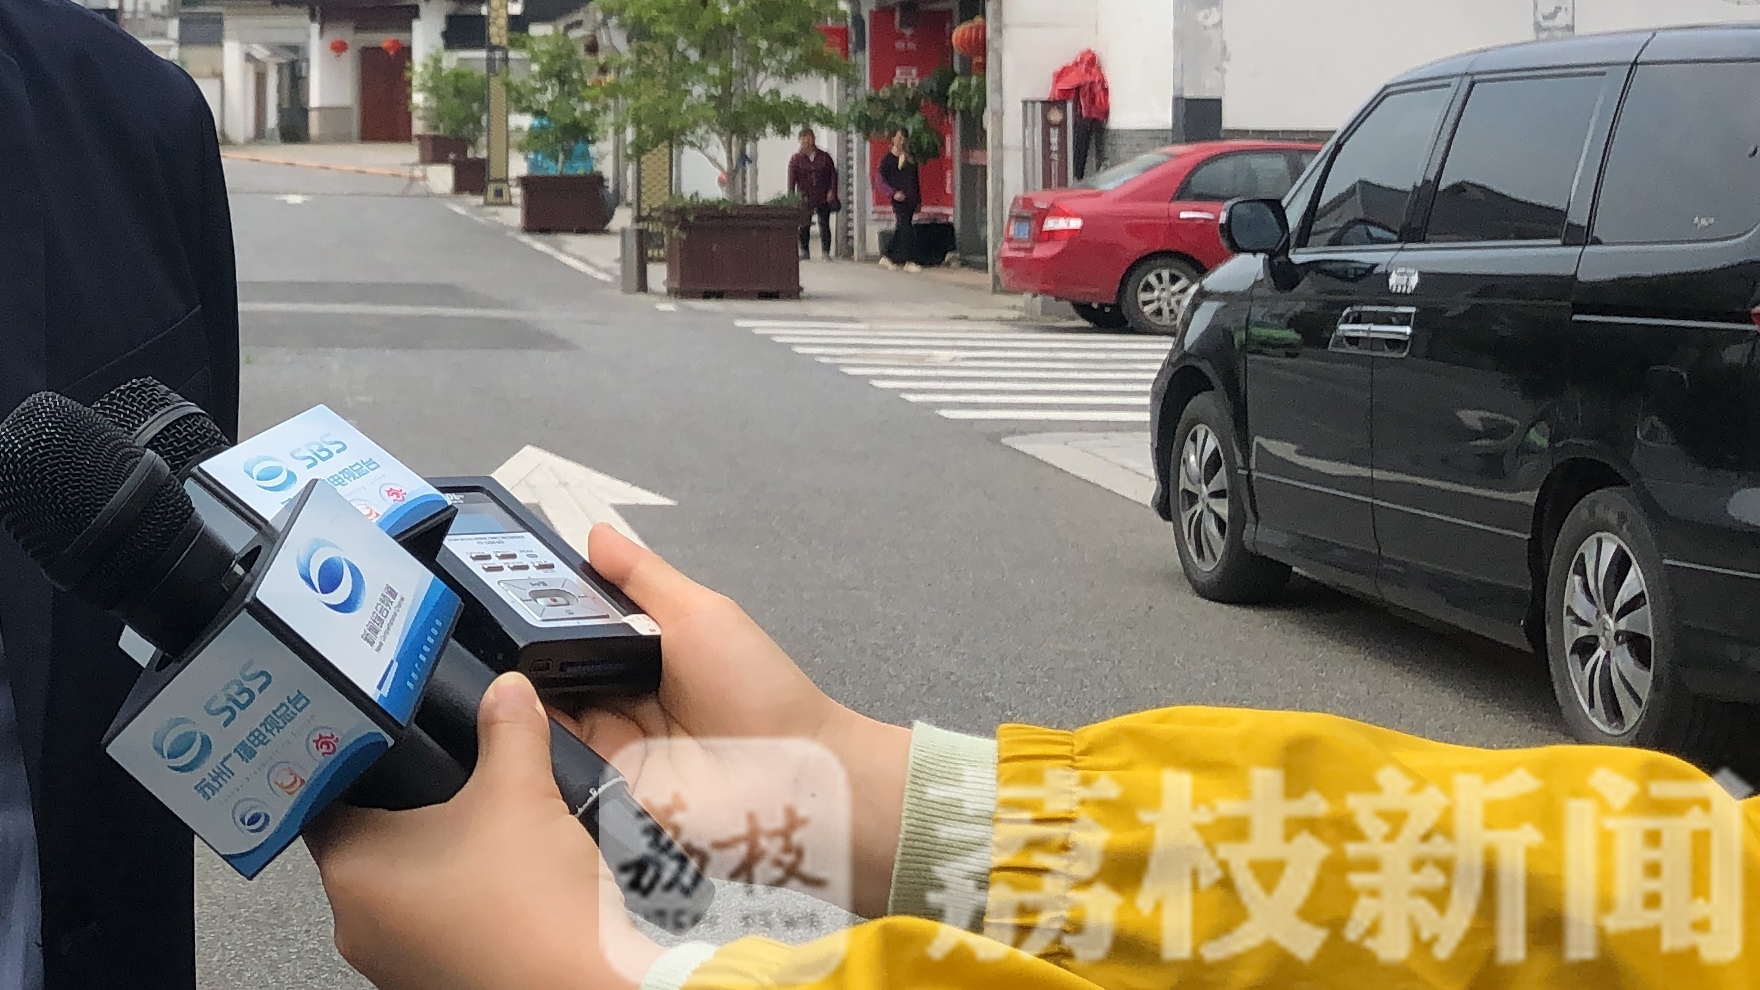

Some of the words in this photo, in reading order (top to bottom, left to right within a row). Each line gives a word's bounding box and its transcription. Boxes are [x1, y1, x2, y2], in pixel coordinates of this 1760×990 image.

[289, 432, 348, 470] SBS
[326, 457, 381, 487] 电视总台
[203, 659, 272, 728] SBS
[193, 689, 311, 802] 苏州广播电视总台
